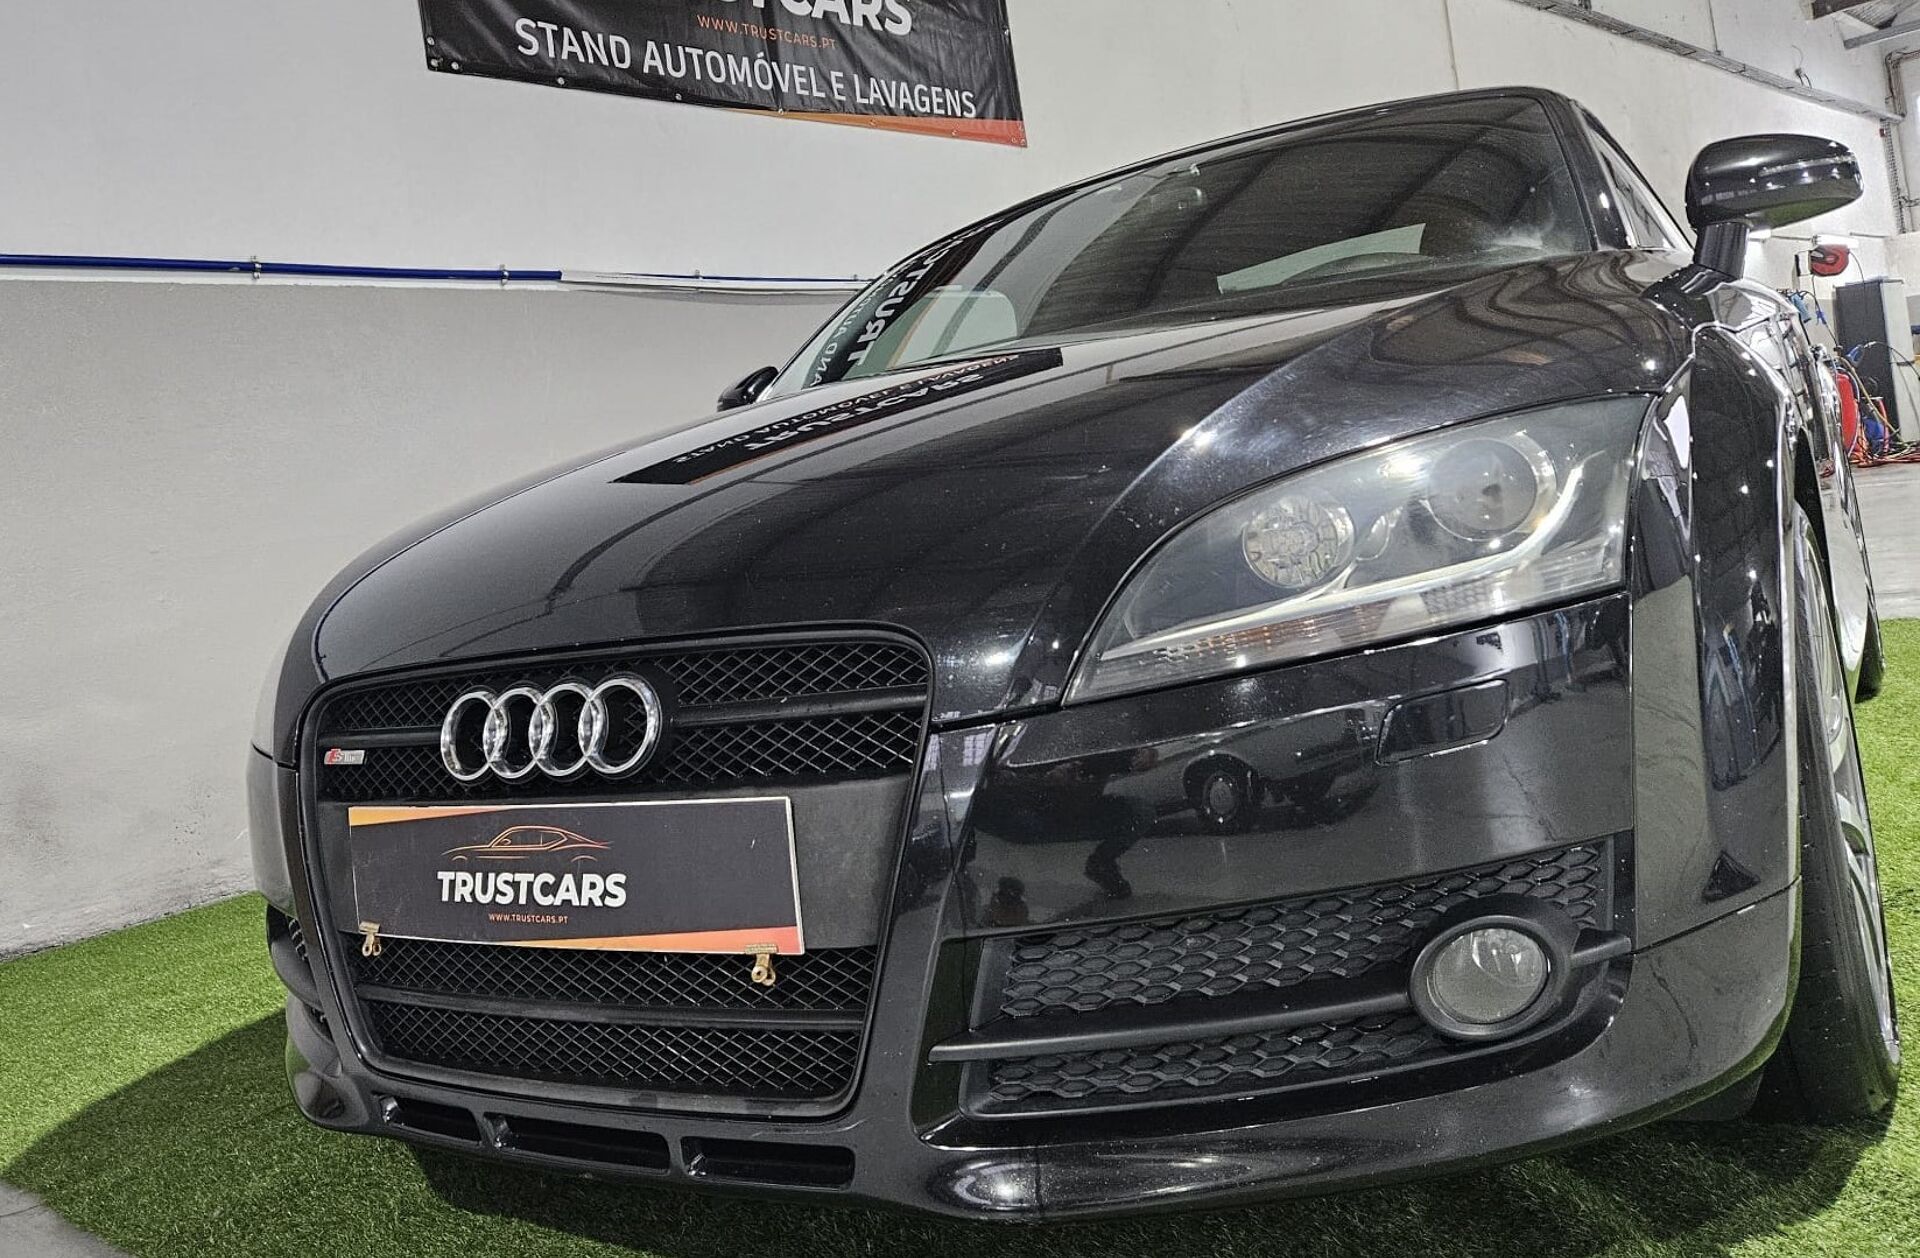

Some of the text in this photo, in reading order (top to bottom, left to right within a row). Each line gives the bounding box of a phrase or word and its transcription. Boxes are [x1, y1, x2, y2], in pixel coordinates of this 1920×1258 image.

[696, 14, 836, 49] WWW.TRUSTCARS.PT
[514, 17, 977, 118] STAND AUTOMÓVEL E LAVAGENS
[437, 871, 627, 908] TRUSTCARS
[488, 912, 569, 924] WWW.TRUSTCARS.PT
